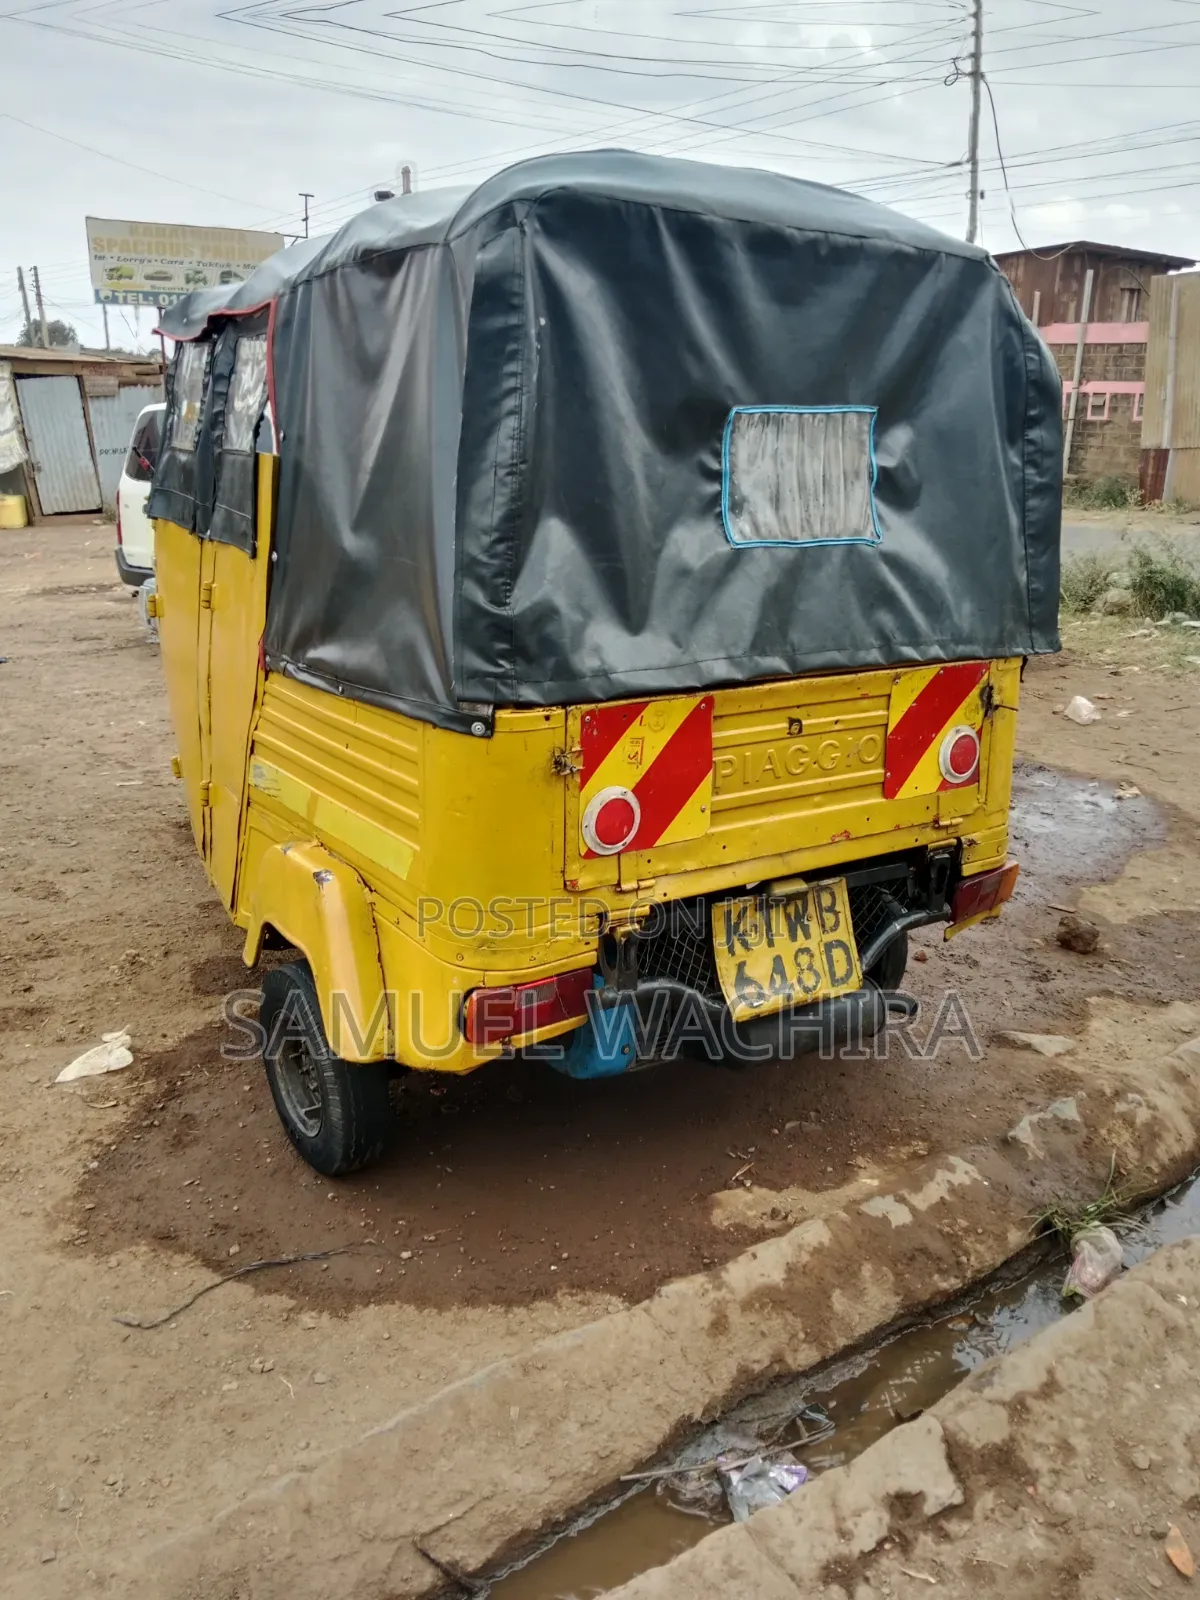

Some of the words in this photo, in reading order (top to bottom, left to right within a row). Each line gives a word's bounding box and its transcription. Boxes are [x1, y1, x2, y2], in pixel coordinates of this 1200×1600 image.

[91, 237, 195, 258] SPACIOUS
[160, 257, 185, 266] Cars
[114, 290, 153, 305] TEL:
[149, 284, 191, 293] Security
[712, 733, 881, 789] PIAGGIO
[733, 939, 854, 1009] 648D
